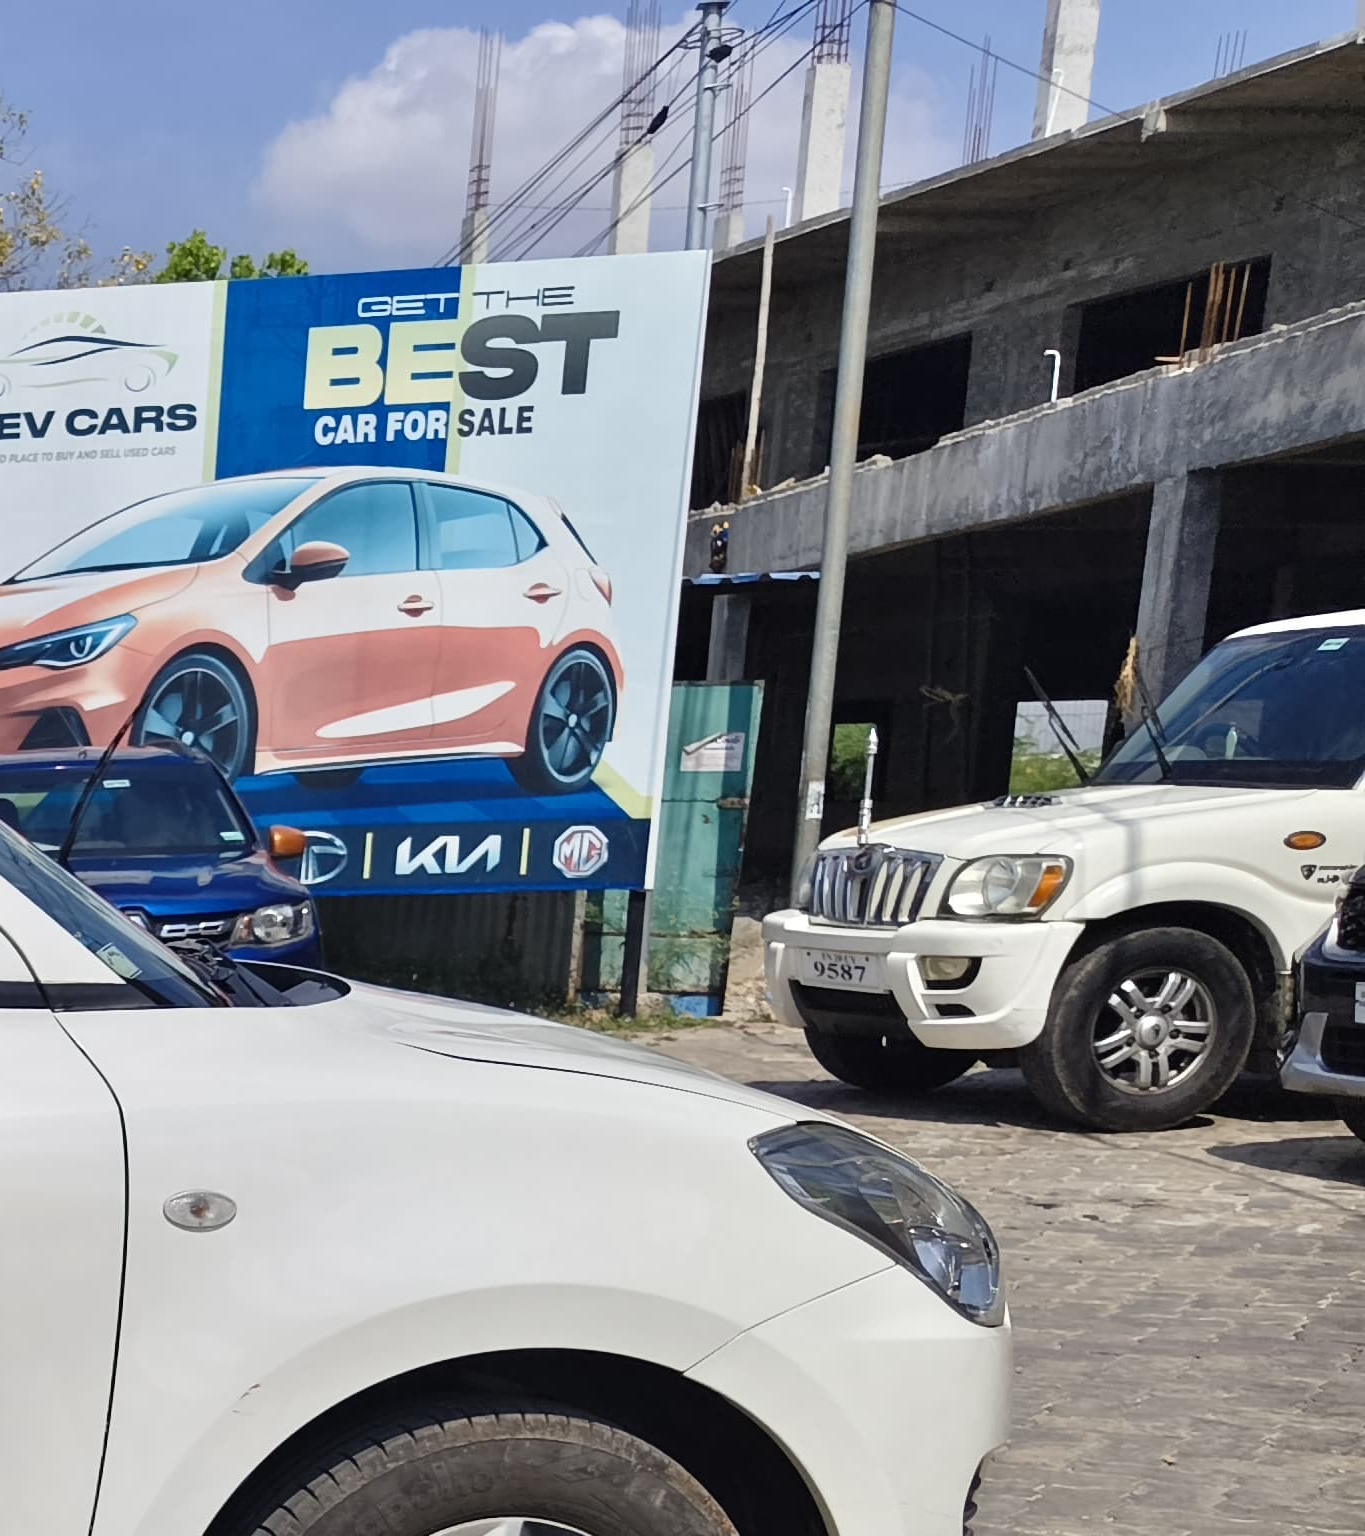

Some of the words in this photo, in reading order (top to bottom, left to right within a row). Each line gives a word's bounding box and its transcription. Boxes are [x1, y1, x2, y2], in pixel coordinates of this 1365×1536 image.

[357, 293, 459, 318] GET
[472, 286, 575, 309] THE
[303, 310, 620, 410] BEST
[65, 403, 197, 437] CARS
[314, 411, 376, 446] CAR
[386, 410, 448, 442] FOR
[456, 405, 534, 438] SALE
[9, 452, 40, 463] PLACE
[41, 451, 54, 462] TO
[55, 451, 75, 461] BUY
[76, 449, 98, 460] AND
[100, 448, 121, 458] SELL
[123, 447, 149, 457] USED
[151, 446, 177, 456] CARS
[558, 831, 603, 872] MG
[813, 960, 866, 983] 9587
